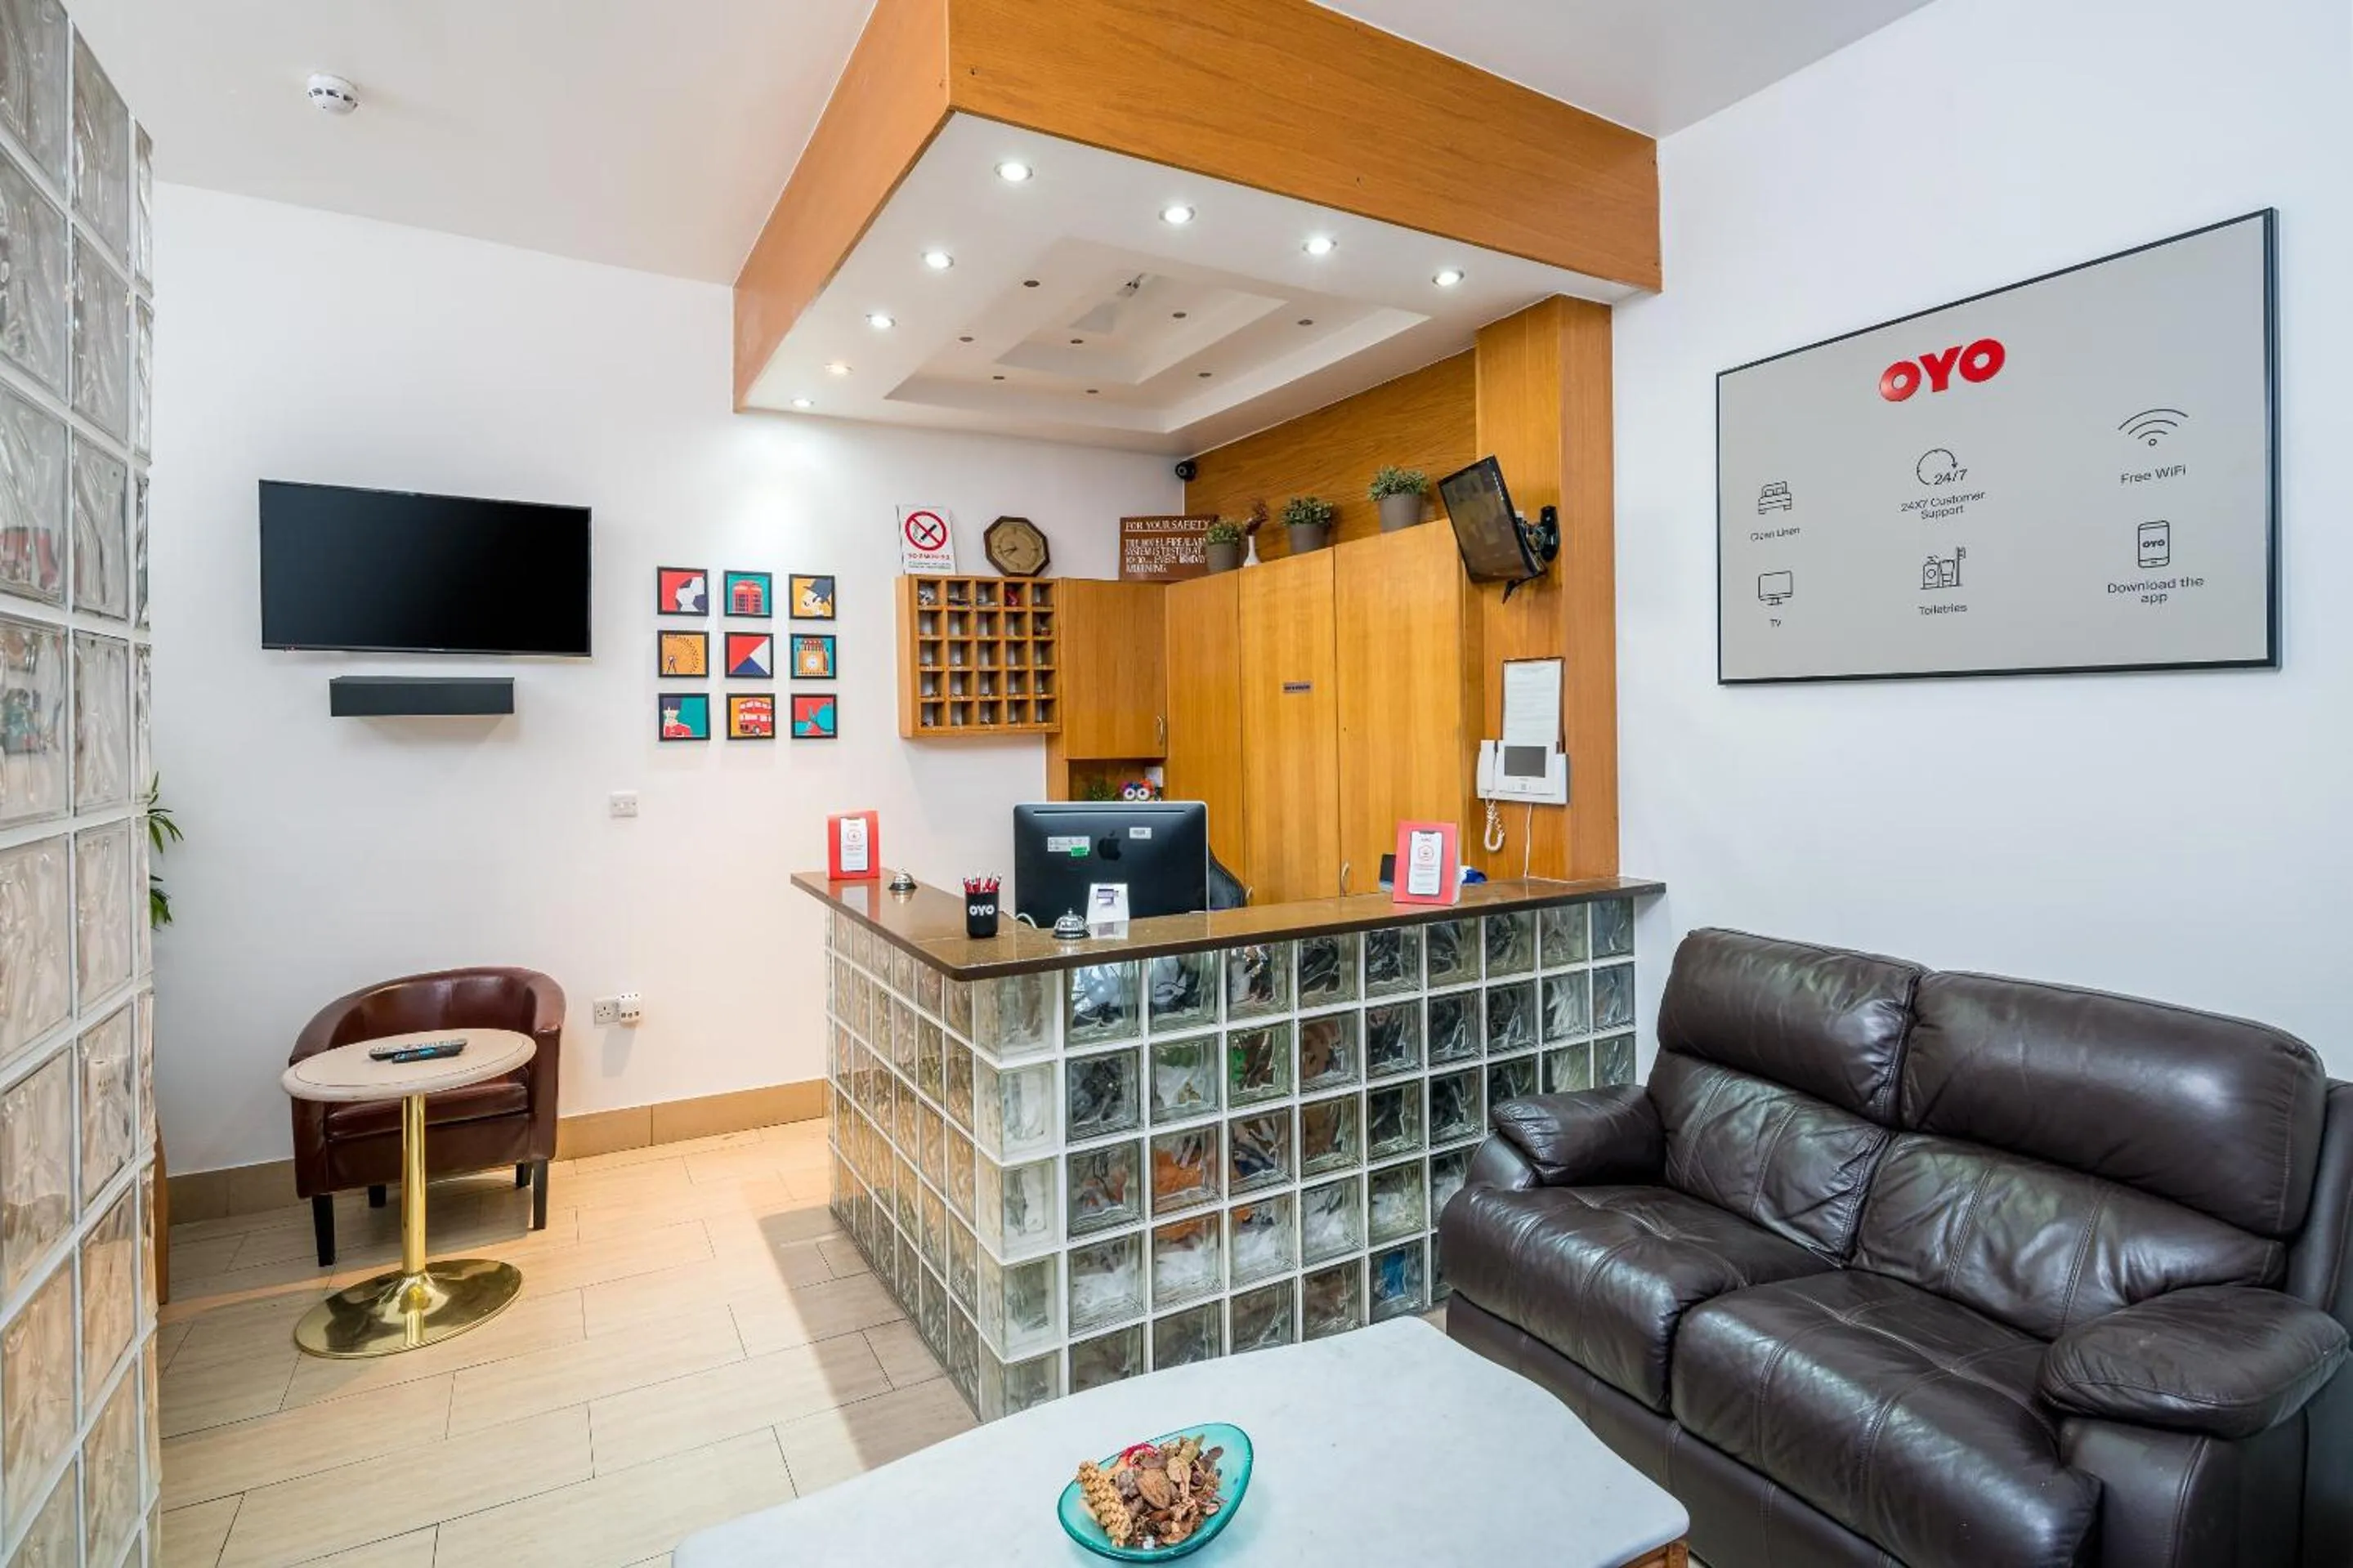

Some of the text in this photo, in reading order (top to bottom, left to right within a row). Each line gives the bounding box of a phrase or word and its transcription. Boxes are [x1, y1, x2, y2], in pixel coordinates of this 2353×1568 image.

[1879, 338, 2006, 402] OYO
[1934, 468, 1967, 485] 24/7
[2120, 473, 2151, 484] Free
[1930, 492, 1985, 507] Customer
[1921, 505, 1963, 519] Support
[1125, 520, 1210, 530] FOR YOUR SAFETY
[2142, 539, 2165, 548] OYO
[2108, 576, 2204, 593] Download the
[2141, 594, 2168, 605] app
[1918, 603, 1968, 615] Toiletries
[1769, 619, 1782, 628] TV
[969, 905, 995, 916] OYO
